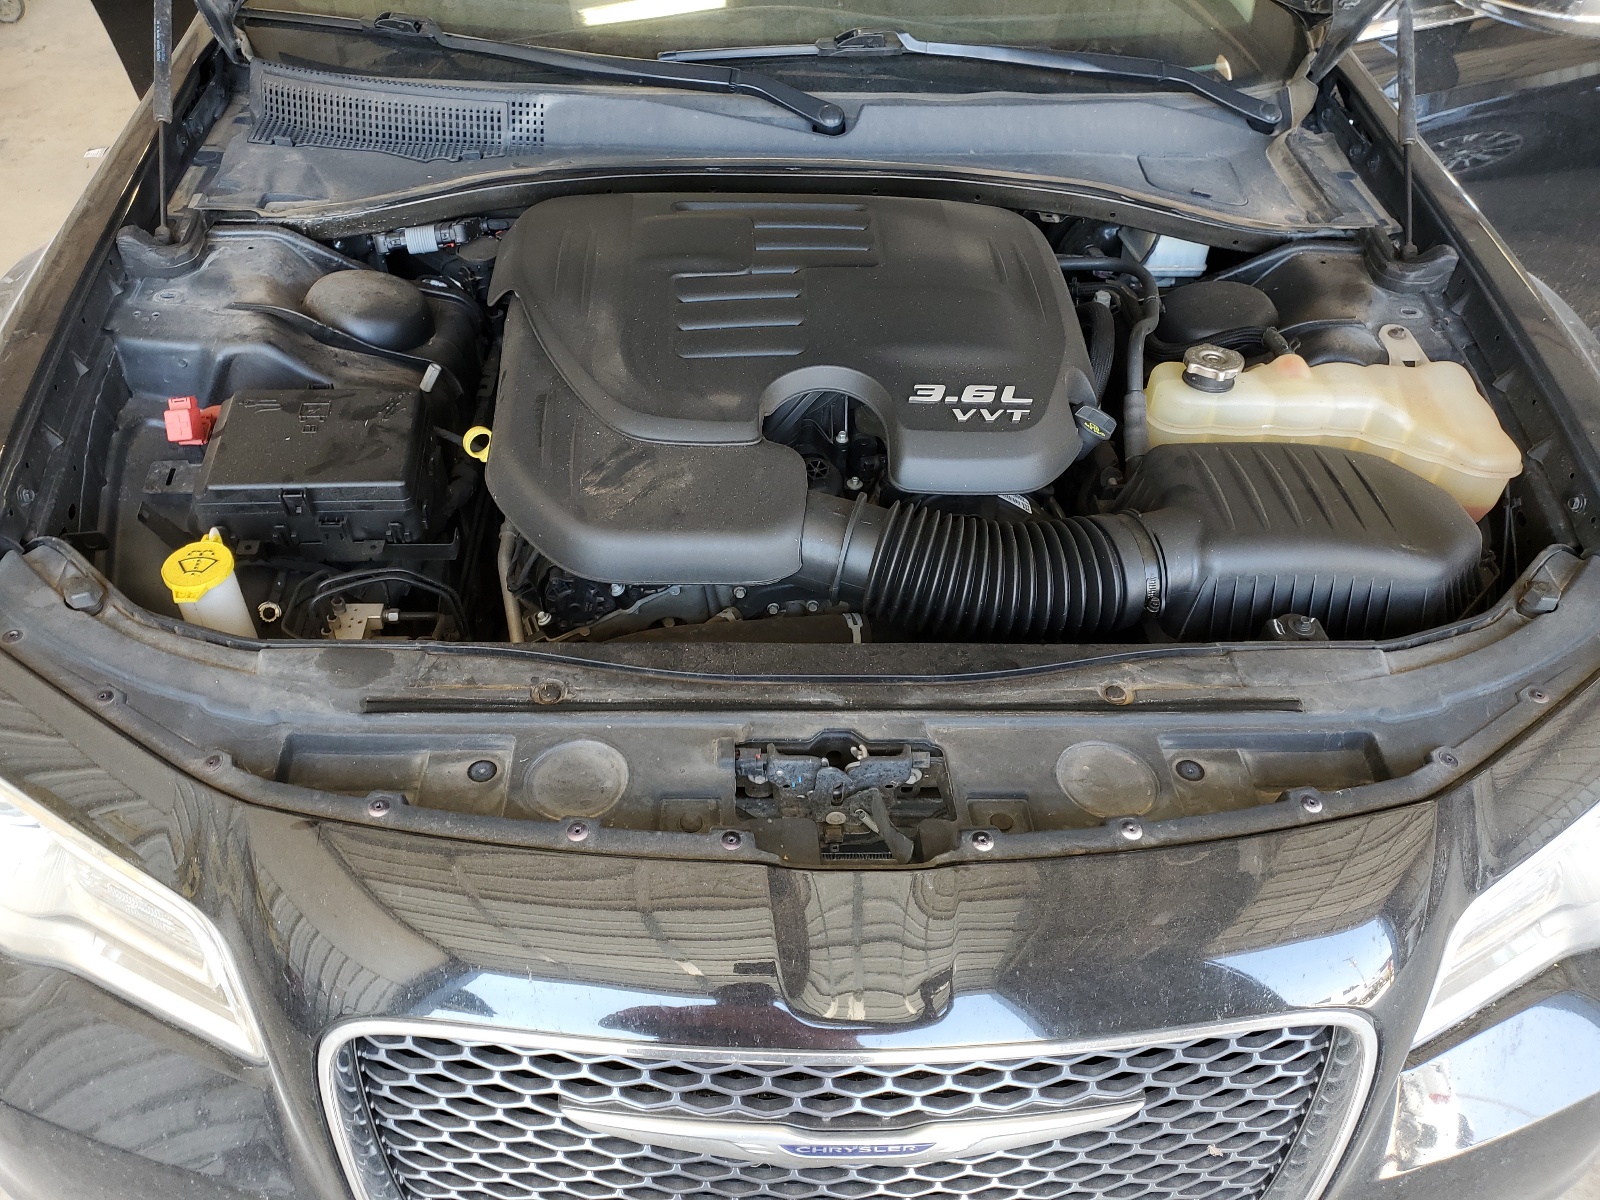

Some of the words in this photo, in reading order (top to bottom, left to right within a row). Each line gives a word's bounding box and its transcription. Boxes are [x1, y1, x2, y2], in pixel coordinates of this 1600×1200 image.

[908, 384, 1033, 406] 3.6L
[951, 408, 1031, 424] VVT
[795, 1145, 917, 1154] CHRYSLER
